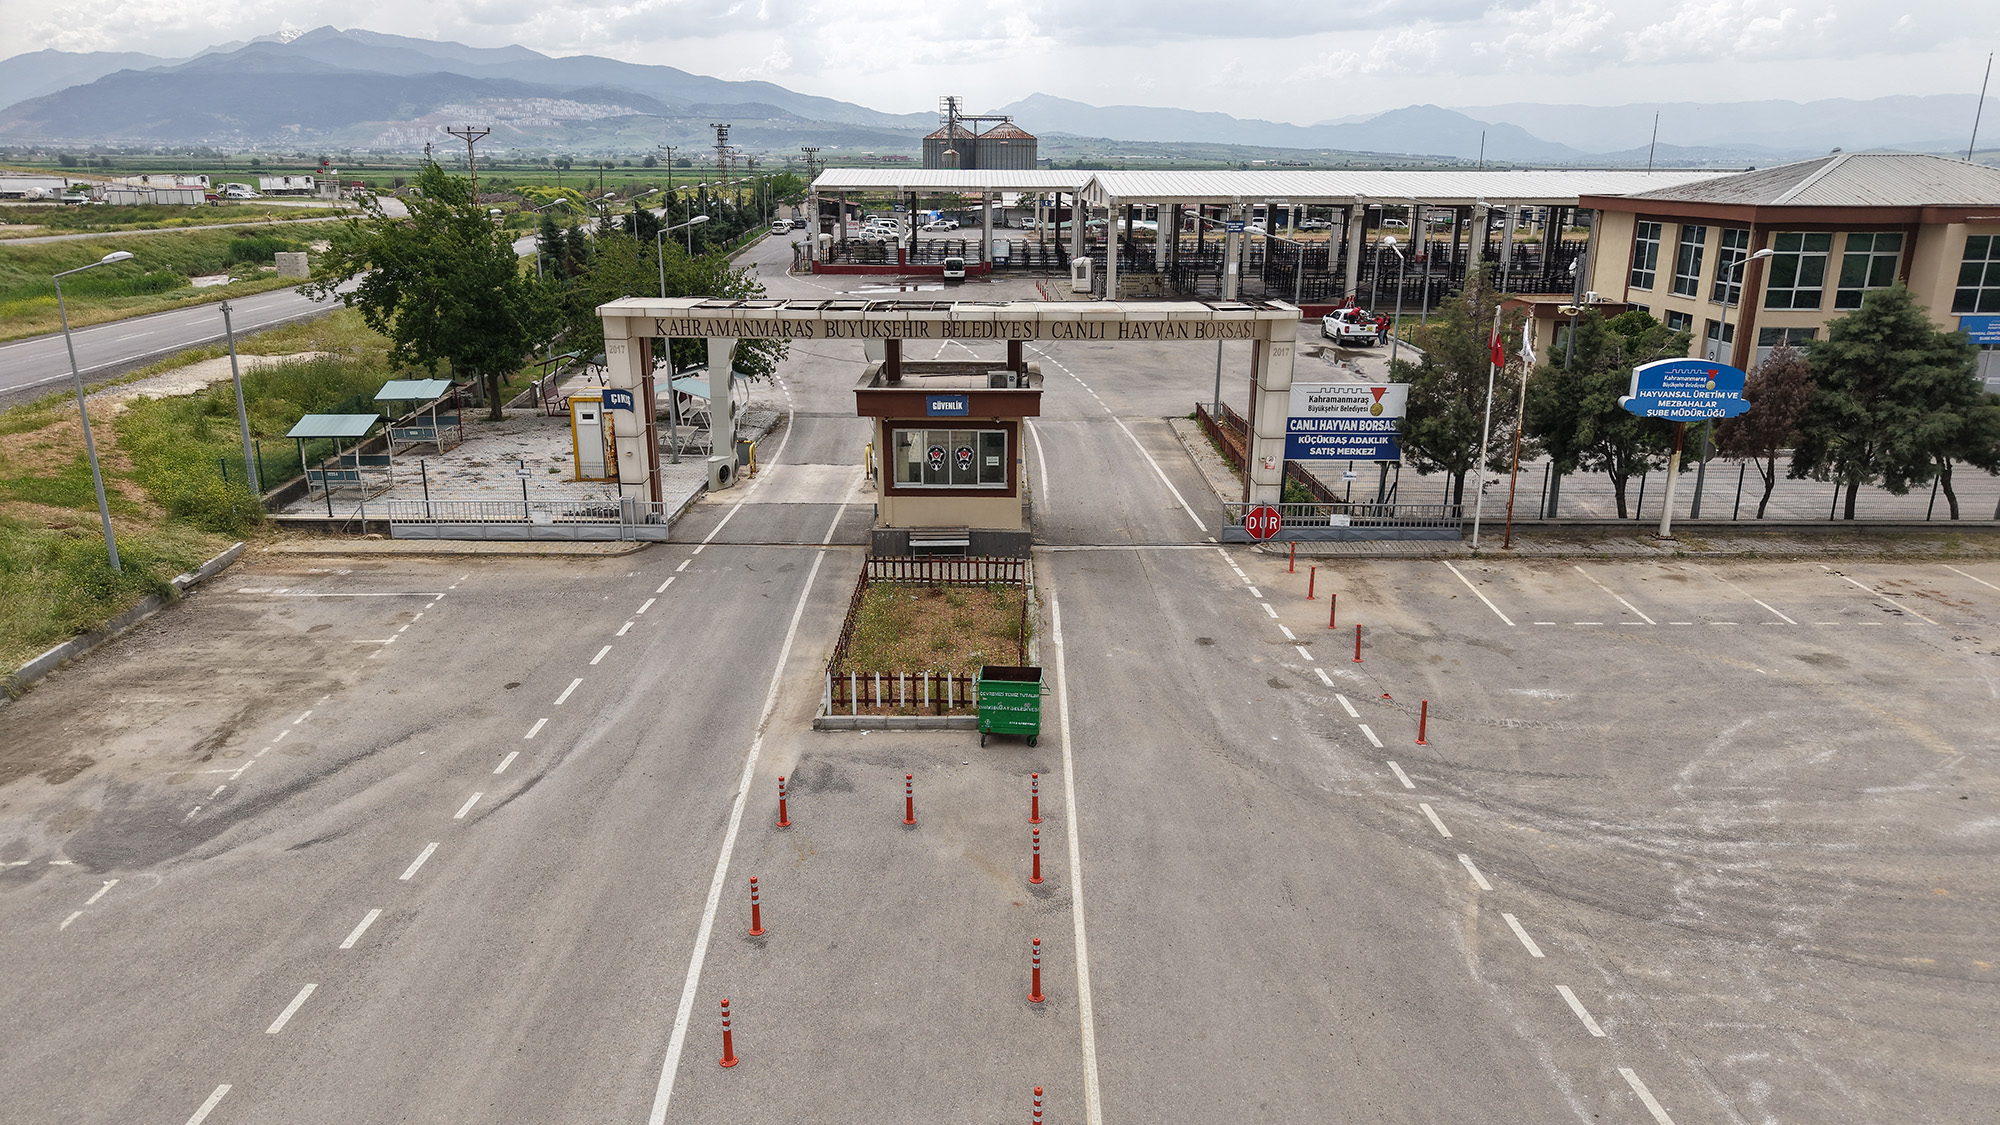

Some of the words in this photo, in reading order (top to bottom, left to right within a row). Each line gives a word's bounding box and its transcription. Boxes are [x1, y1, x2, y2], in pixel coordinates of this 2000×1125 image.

[655, 318, 814, 339] KAHRAMANMARAŞ
[1051, 321, 1106, 339] CANLI
[1118, 321, 1189, 339] HAYVAN
[1194, 321, 1257, 339] BORSASI
[608, 345, 626, 354] 2017
[1272, 347, 1290, 357] 2017
[1640, 390, 1692, 398] HAYVANSAL
[1693, 390, 1726, 399] ÜRETİM
[610, 393, 631, 407] ÇIKIŞ
[932, 400, 963, 410] GÜVENLİK
[1308, 395, 1370, 405] Kahramanmaraş
[1657, 400, 1718, 408] MEZBAHALAR
[1307, 405, 1339, 413] Büyükşehir
[1340, 405, 1369, 413] Belediyesi
[1646, 409, 1669, 418] ŞUBE
[1670, 408, 1726, 418] MÜDÜRLÜĞÜ
[1290, 419, 1319, 431] CANLI
[1320, 419, 1358, 431] HAYVAN
[1298, 435, 1348, 445] KÜÇÜKBAŞ
[1348, 436, 1389, 444] ADAKLIK
[1309, 447, 1336, 457] SATIŞ
[1336, 446, 1377, 456] MERKEZİ
[1248, 516, 1278, 530] DUR
